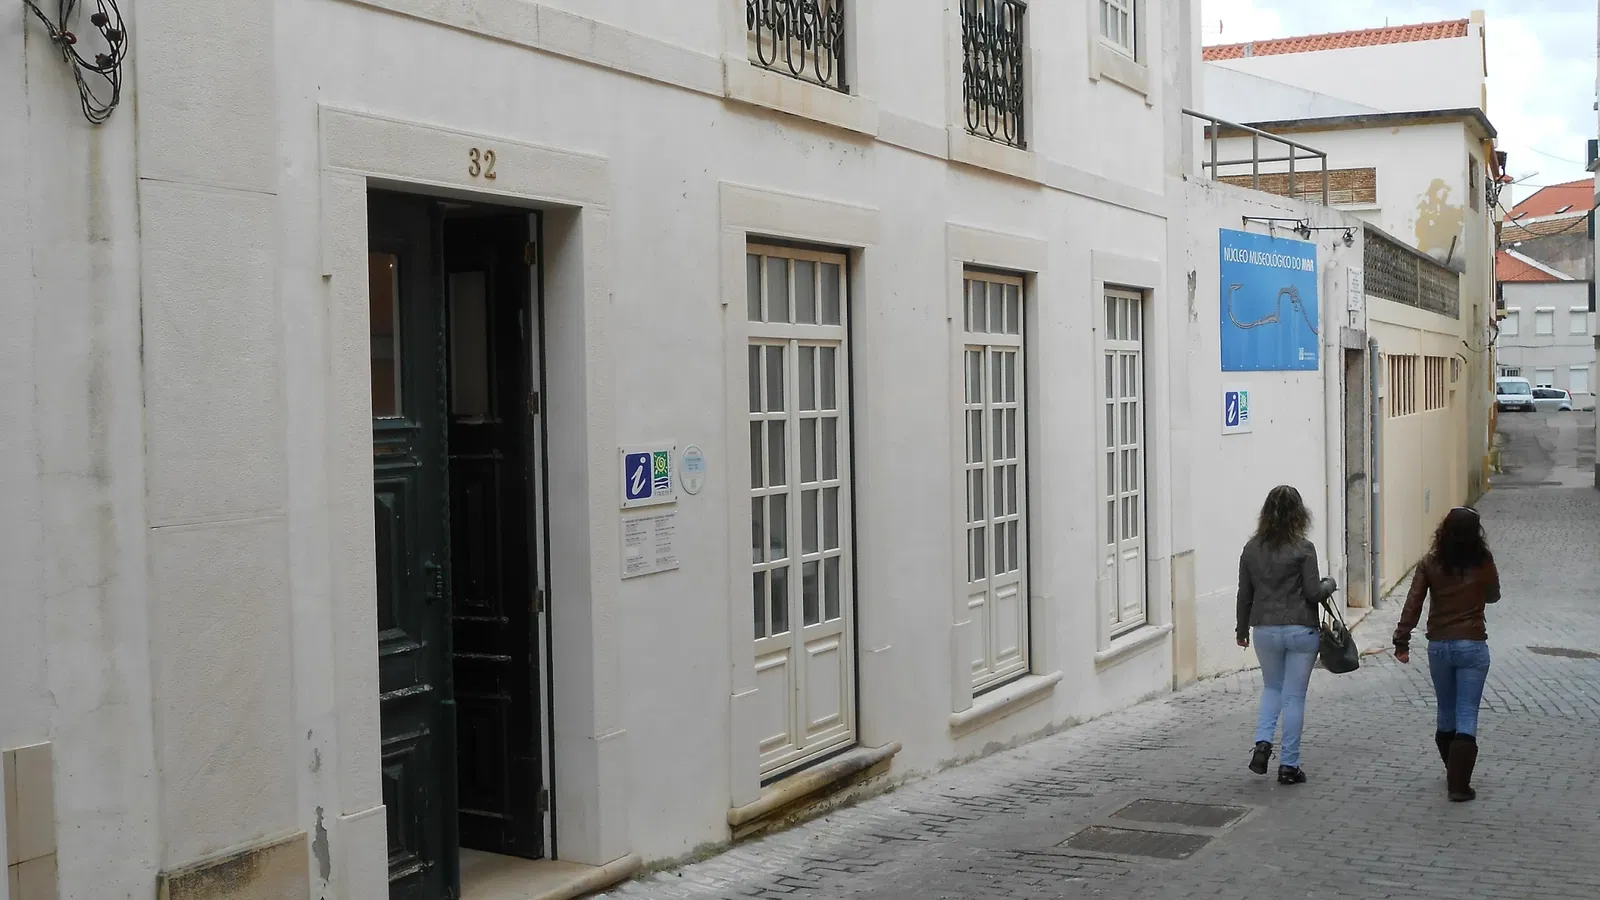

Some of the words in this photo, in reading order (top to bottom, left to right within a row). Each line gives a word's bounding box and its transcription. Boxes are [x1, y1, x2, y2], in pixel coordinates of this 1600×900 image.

[469, 148, 496, 179] 32
[1224, 244, 1248, 264] NÚCLEO
[1249, 250, 1291, 269] MUSEOLÓGICO
[1292, 256, 1301, 271] DO
[1301, 258, 1314, 272] MAR
[631, 457, 646, 495] i
